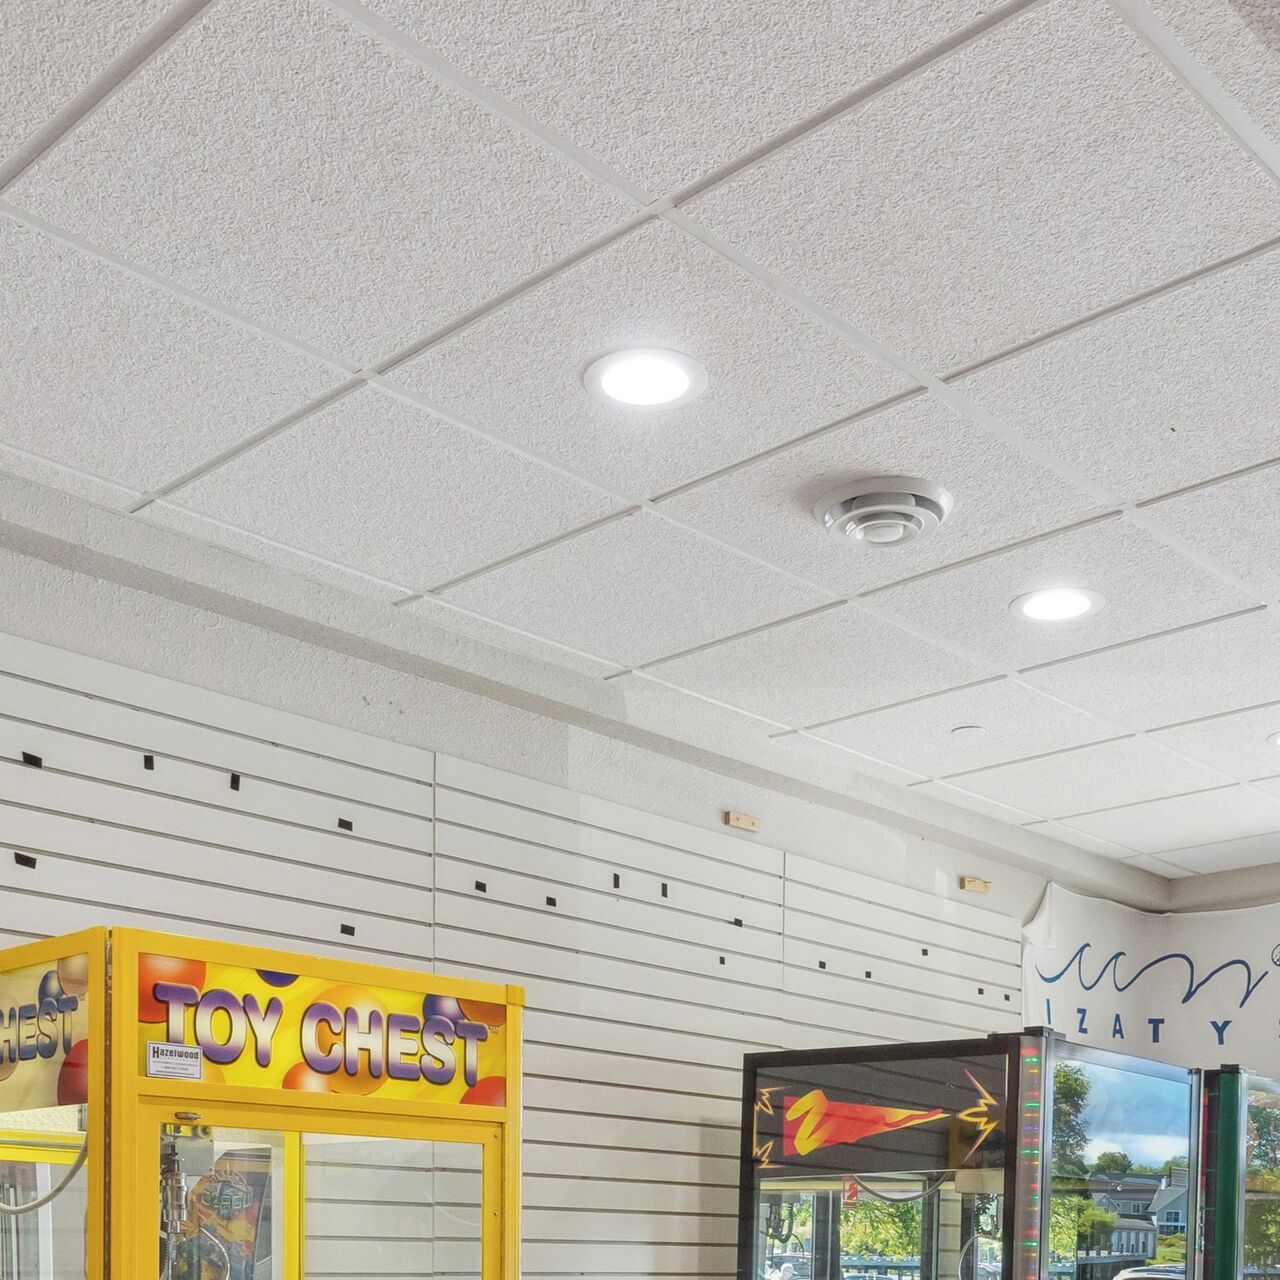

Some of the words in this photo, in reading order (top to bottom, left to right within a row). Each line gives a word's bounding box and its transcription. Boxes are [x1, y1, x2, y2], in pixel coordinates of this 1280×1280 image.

[152, 981, 285, 1069] TOY
[300, 1001, 488, 1088] CHEST
[152, 1046, 199, 1059] Hazelwood
